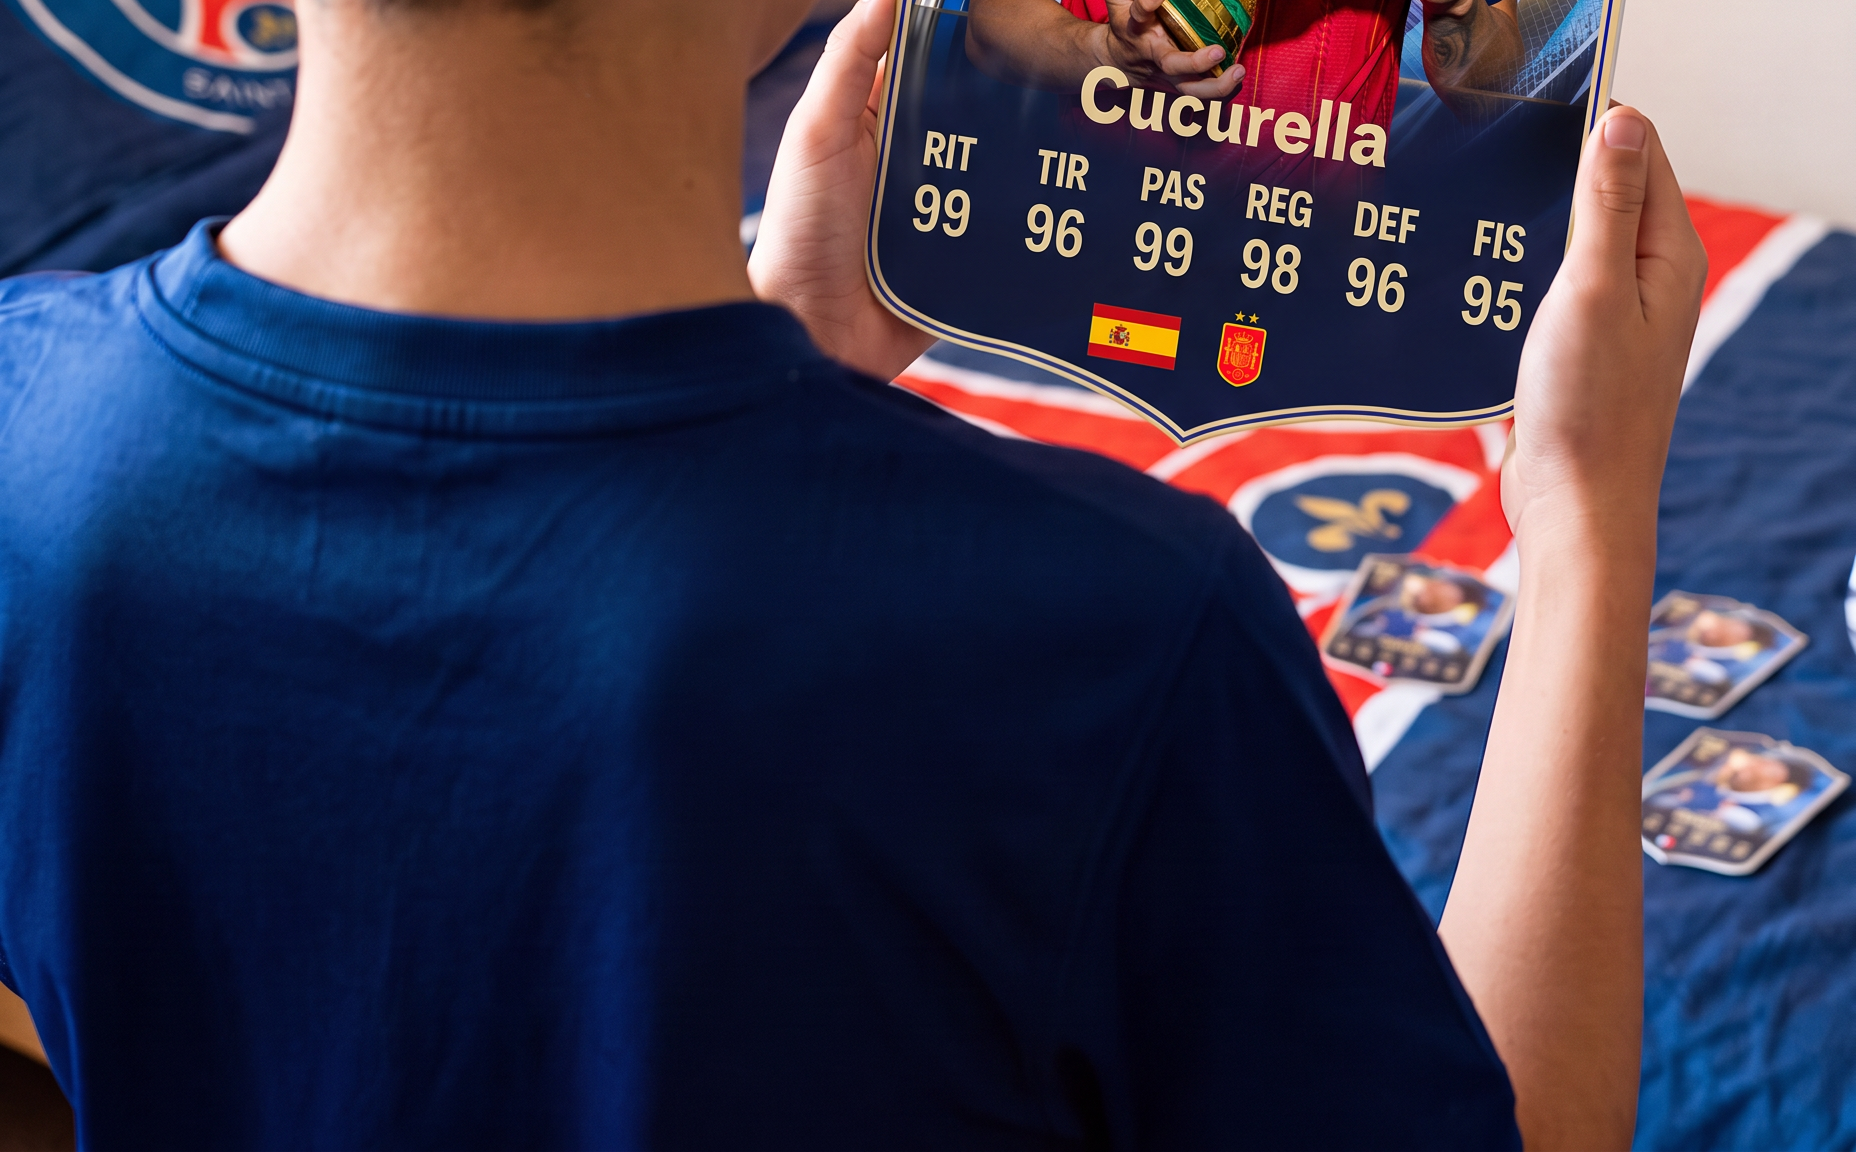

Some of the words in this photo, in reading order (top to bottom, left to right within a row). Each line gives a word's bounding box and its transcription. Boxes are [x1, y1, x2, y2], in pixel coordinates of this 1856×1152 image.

[1080, 65, 1387, 168] Cucurella
[912, 184, 971, 237] 99
[1025, 203, 1085, 258] 96
[1133, 221, 1194, 277] 99
[1240, 238, 1301, 295] 98
[1345, 257, 1408, 313] 96
[1461, 275, 1524, 331] 95
[923, 130, 978, 172] RIT
[1038, 149, 1089, 191] TIR
[1140, 166, 1206, 210] PAS
[1245, 183, 1313, 228] REG
[1353, 201, 1420, 244] DEF
[1473, 219, 1527, 263] FIS
